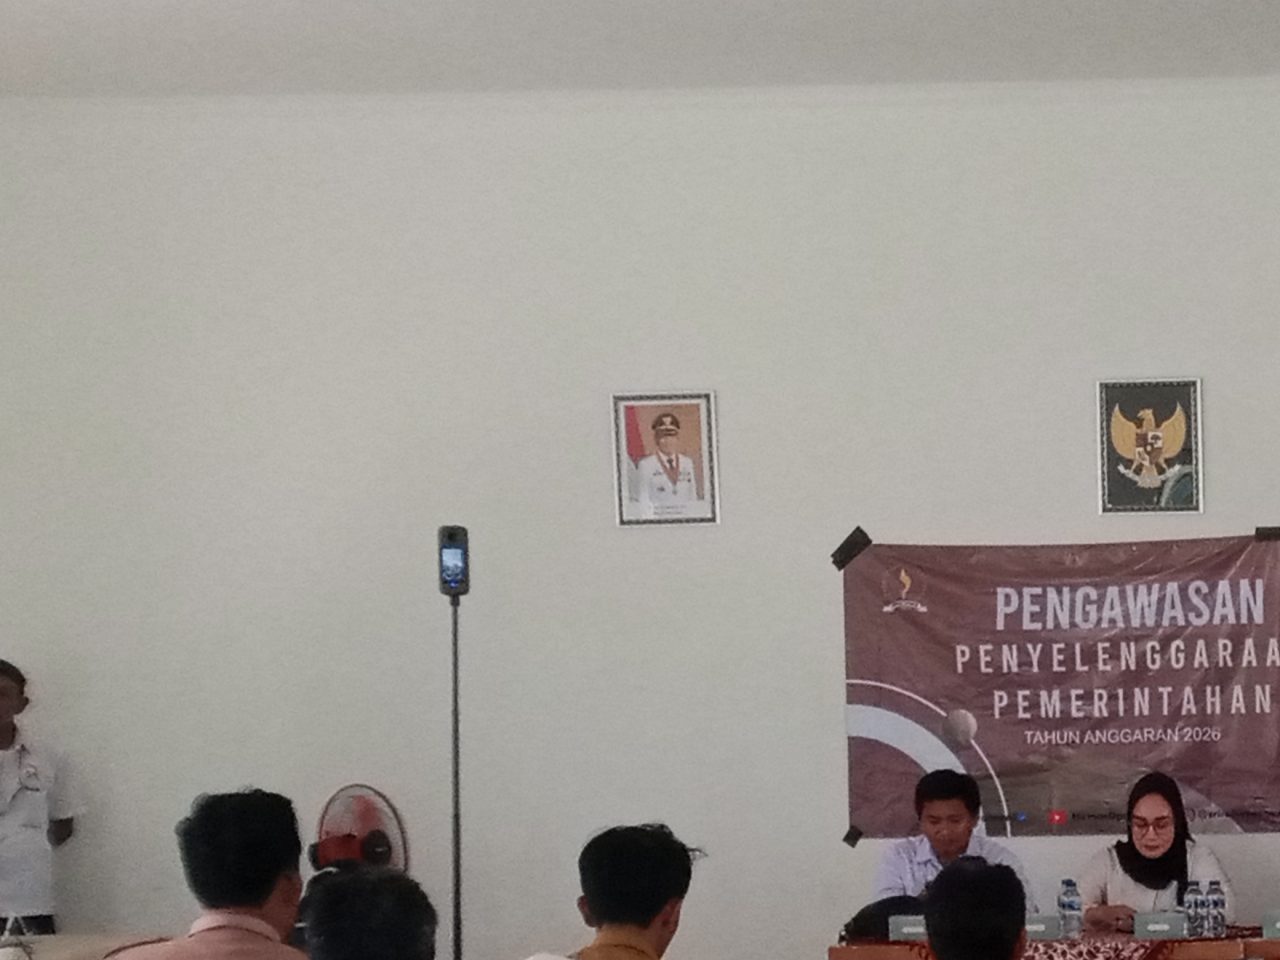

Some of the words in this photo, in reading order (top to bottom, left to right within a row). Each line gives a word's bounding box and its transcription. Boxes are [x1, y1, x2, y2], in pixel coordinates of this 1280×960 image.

[995, 577, 1265, 631] PENGAWASAN
[993, 684, 1272, 720] PEMERINTAHAN
[1023, 730, 1081, 745] TAHUN
[1082, 728, 1179, 744] ANGGARAN
[1182, 726, 1222, 742] 2026
